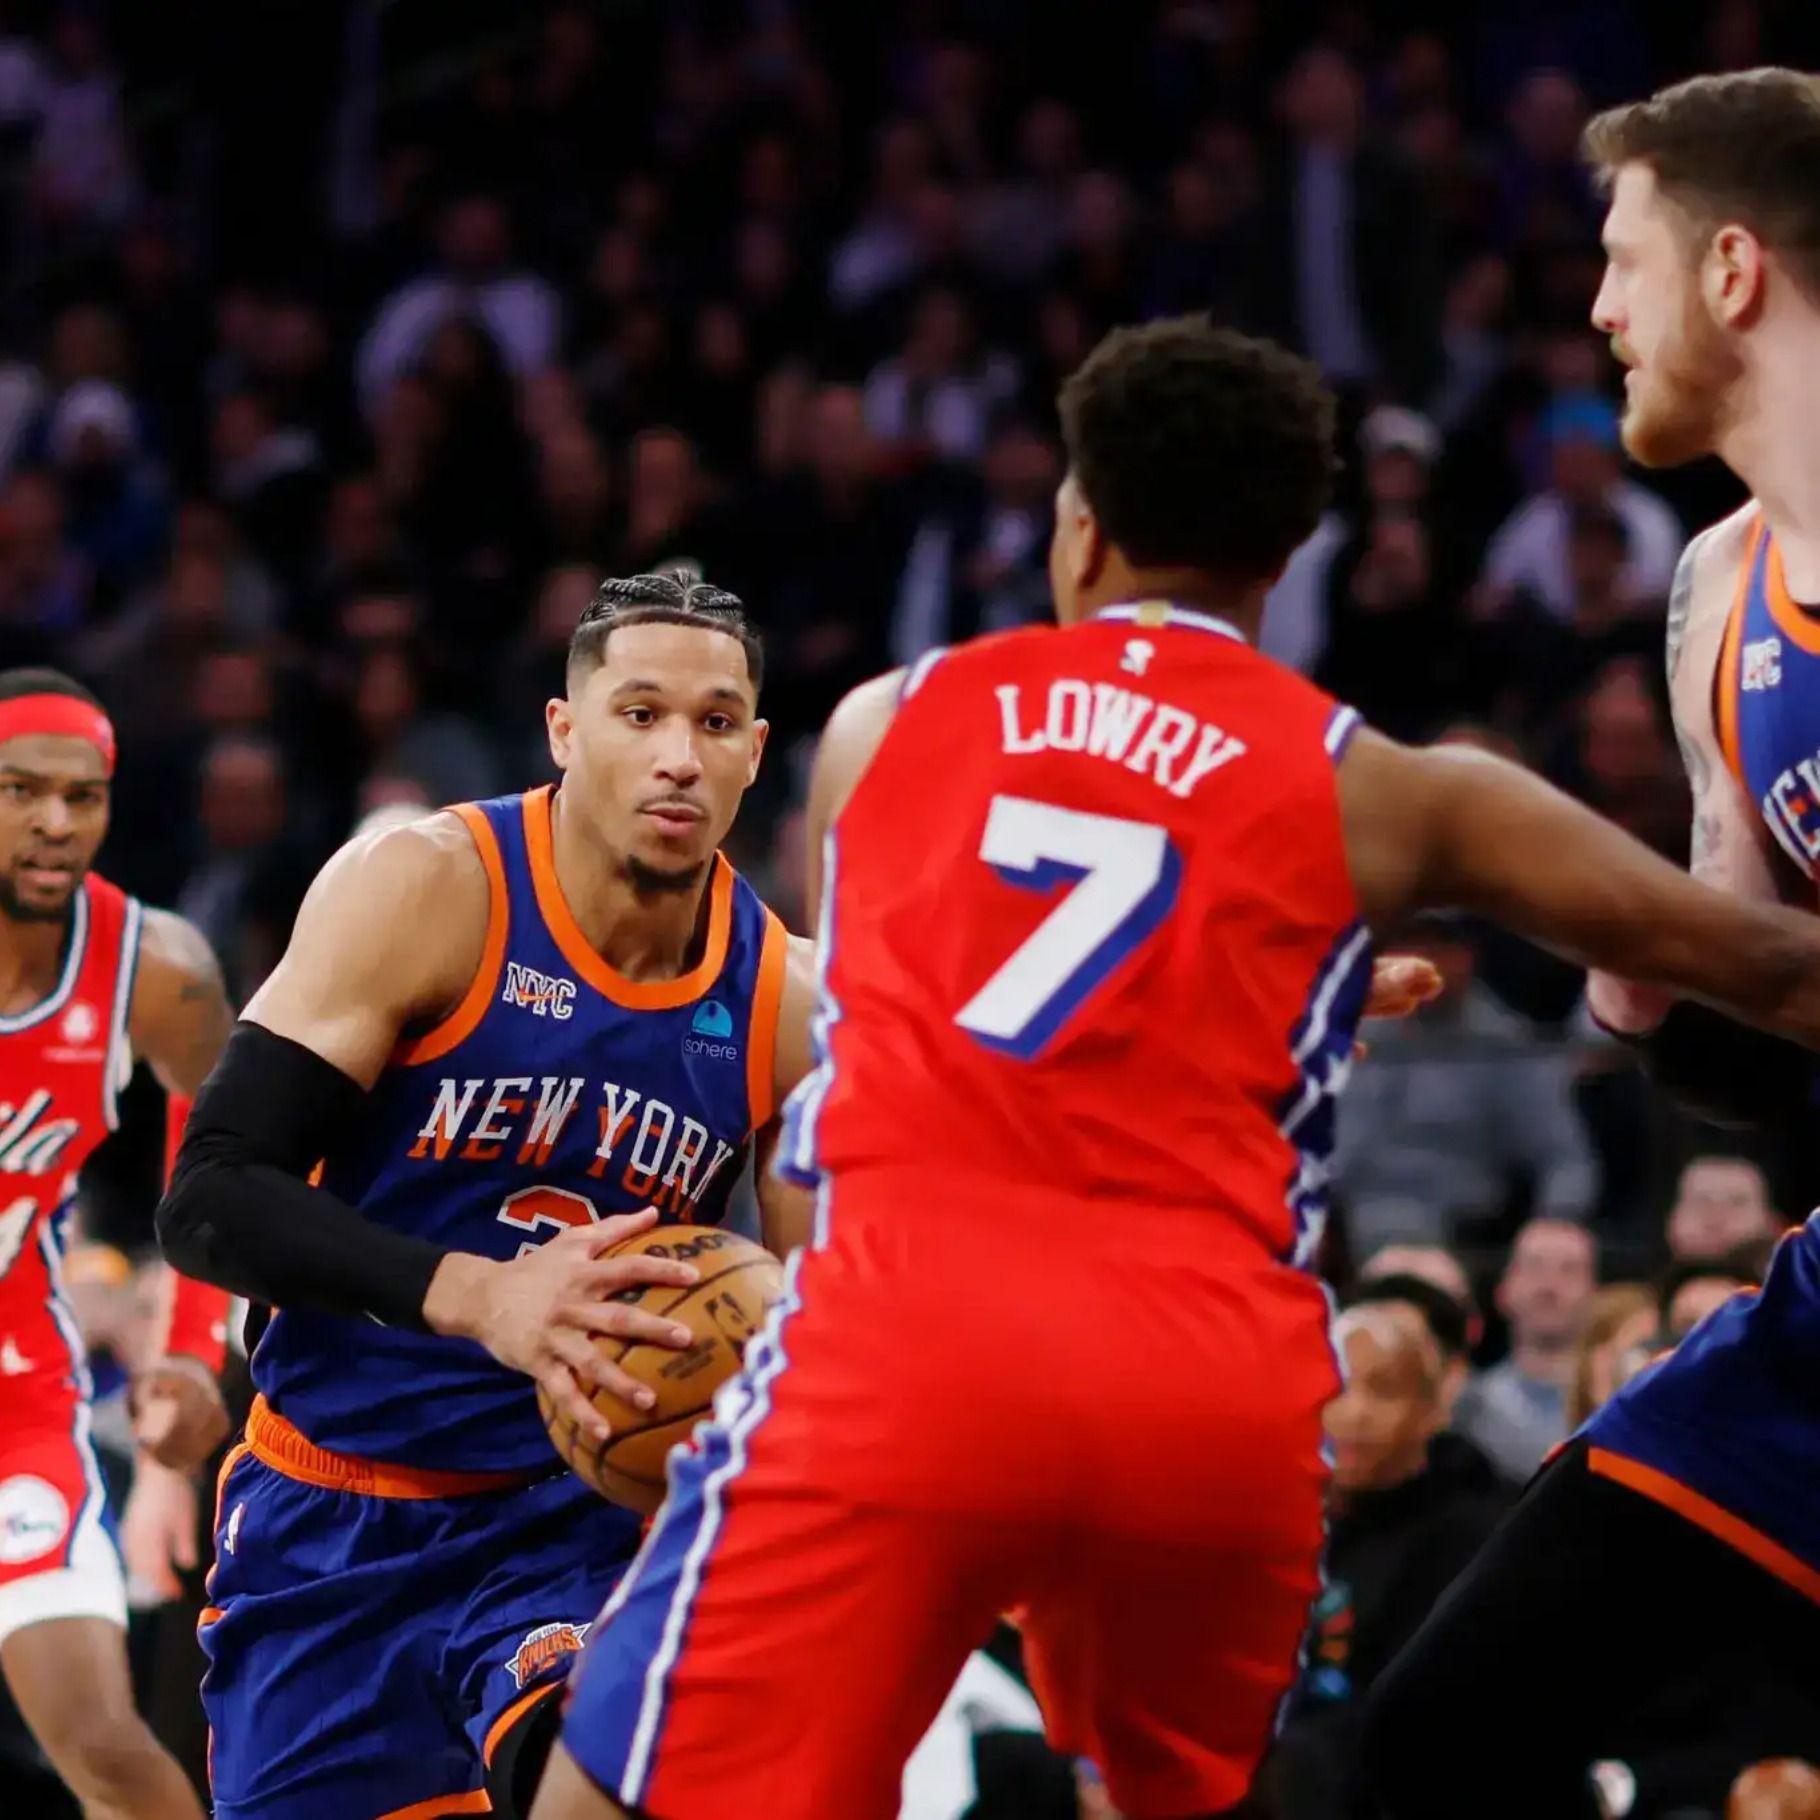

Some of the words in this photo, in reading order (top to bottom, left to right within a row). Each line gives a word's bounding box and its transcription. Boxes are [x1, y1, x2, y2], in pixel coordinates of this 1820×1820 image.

[995, 678, 1248, 798] LOWRY
[953, 795, 1180, 1060] 7
[502, 961, 577, 1020] NYC
[685, 1037, 738, 1061] sphere
[418, 1076, 585, 1146] NEW
[595, 1081, 735, 1203] YORK
